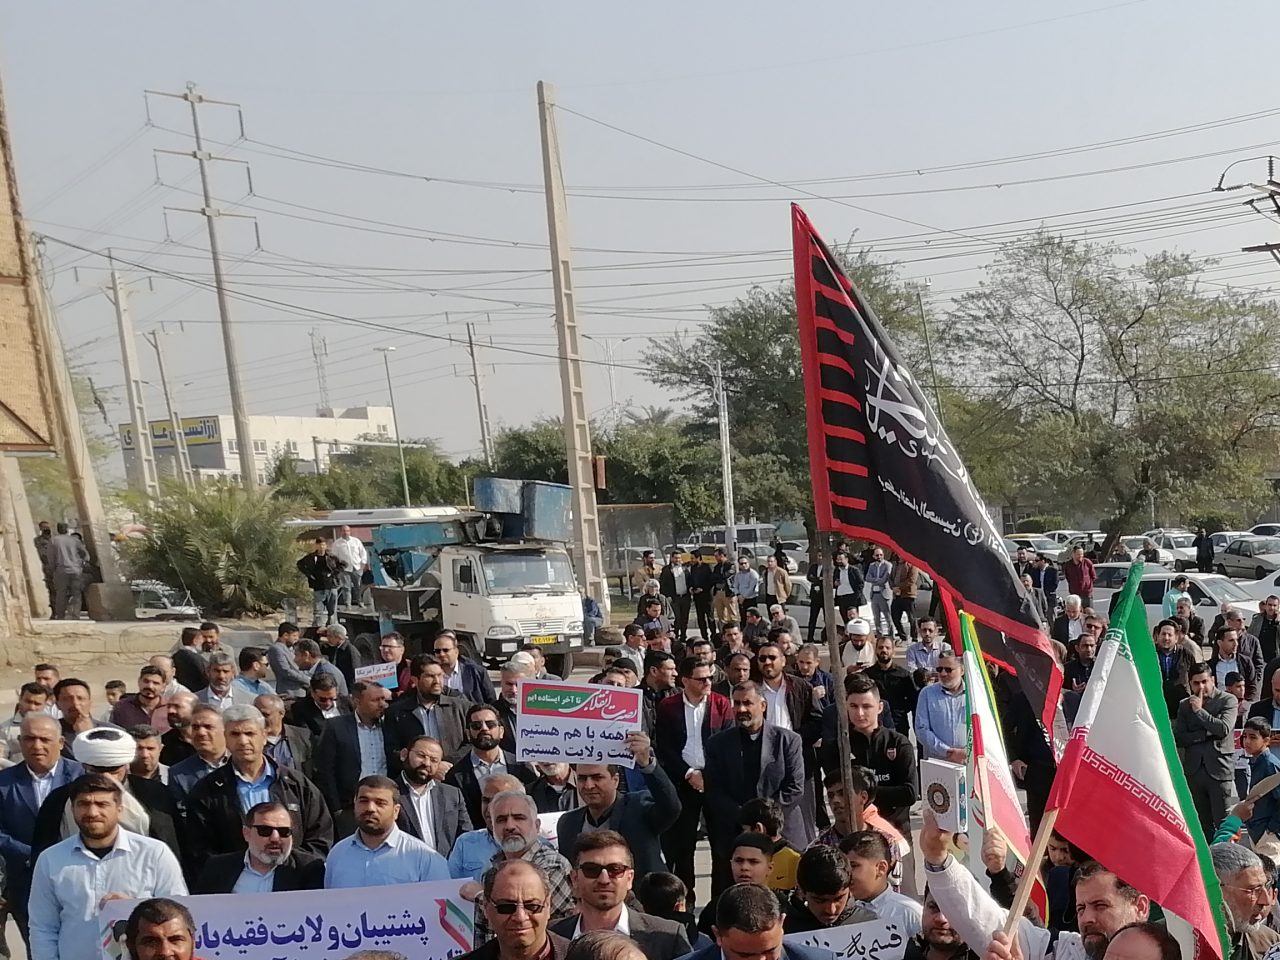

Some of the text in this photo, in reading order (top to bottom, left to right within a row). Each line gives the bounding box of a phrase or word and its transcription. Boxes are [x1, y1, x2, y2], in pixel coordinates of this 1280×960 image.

[520, 724, 560, 739] هستیم
[564, 729, 581, 742] هم
[586, 726, 595, 742] با
[521, 743, 561, 758] هستیم
[564, 744, 603, 762] ولایت
[222, 916, 269, 954] فقیه
[270, 912, 340, 951] ولایت
[341, 909, 429, 946] پشتیبان
